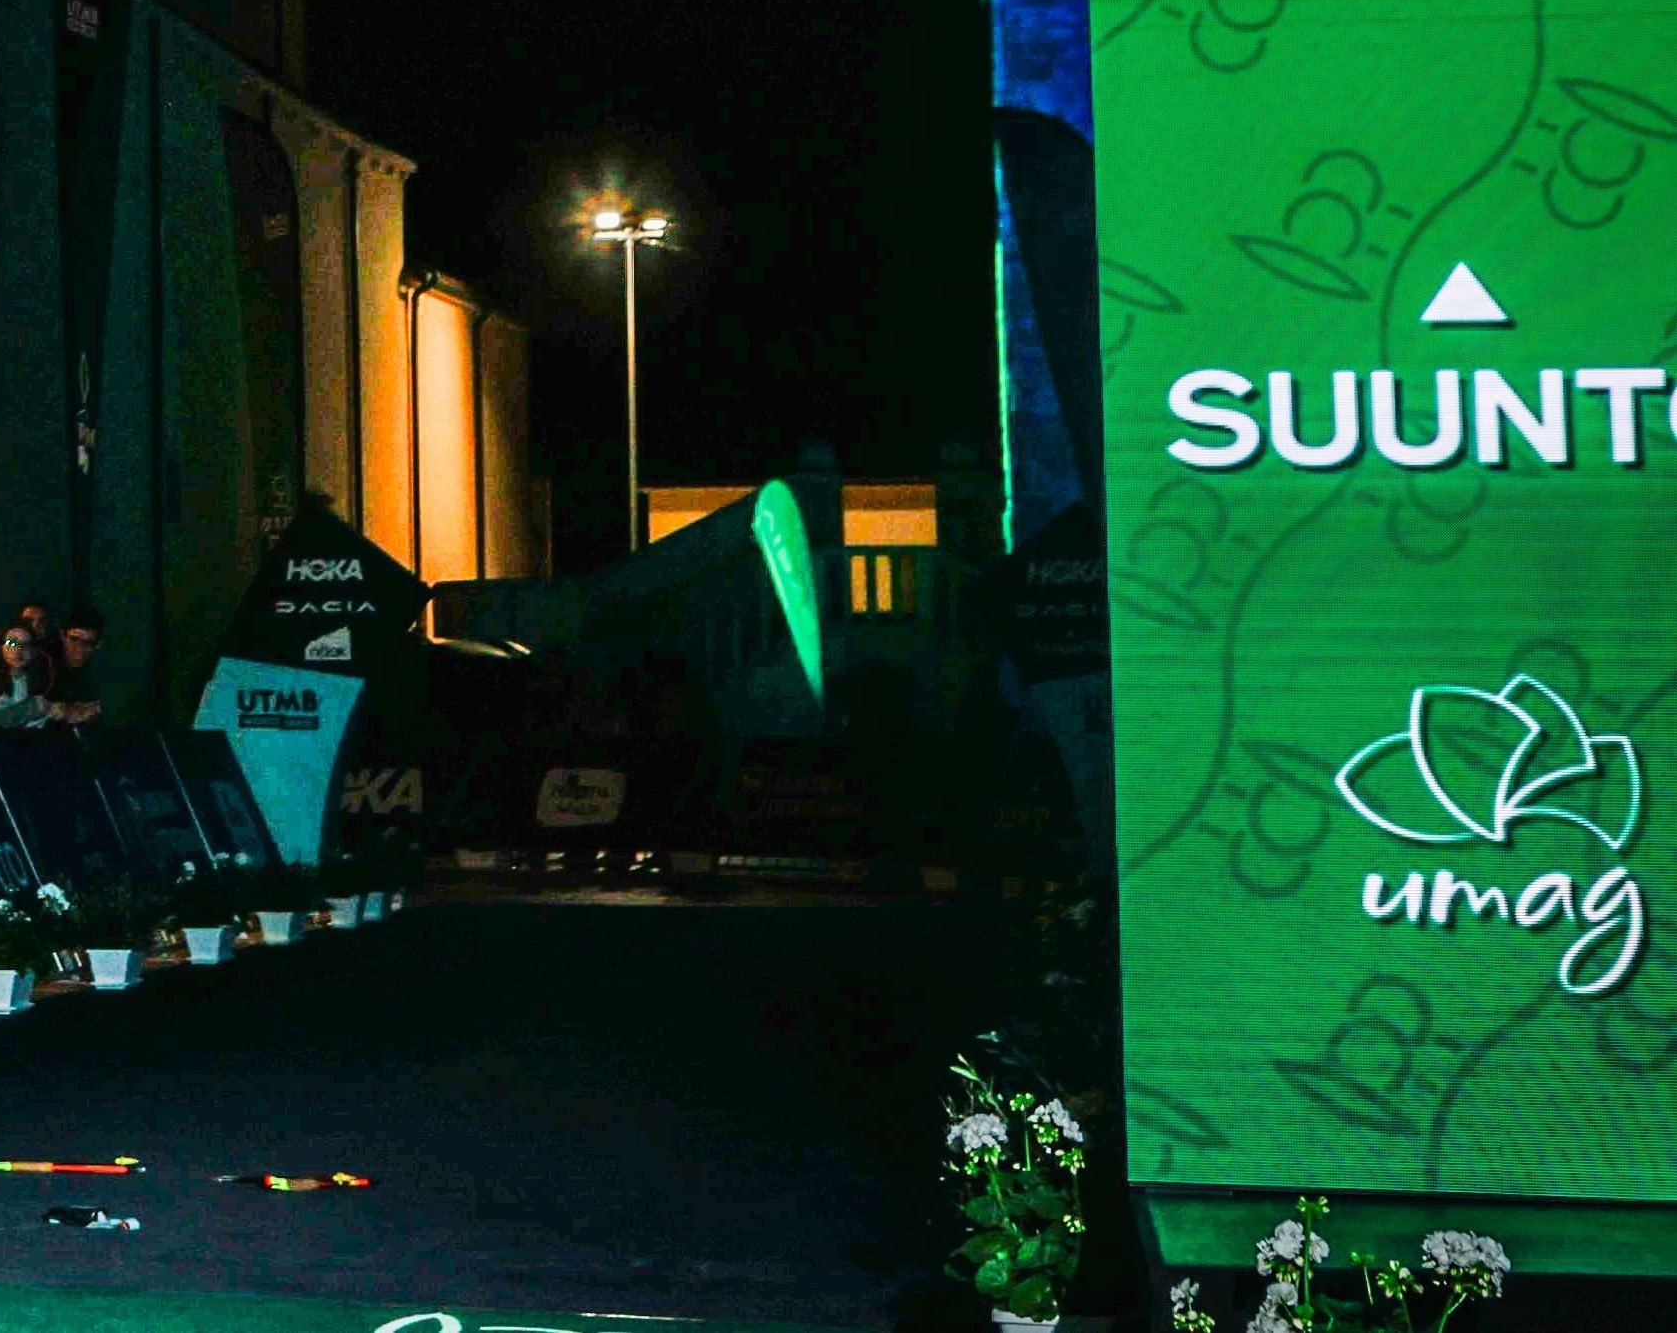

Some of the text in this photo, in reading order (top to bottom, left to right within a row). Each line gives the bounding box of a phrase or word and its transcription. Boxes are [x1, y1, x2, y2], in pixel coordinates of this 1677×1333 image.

[1167, 368, 1677, 467] SUUNT
[287, 559, 363, 581] HOKA
[276, 600, 376, 614] DACIA
[237, 688, 318, 712] UTMB
[1362, 868, 1643, 995] umag
